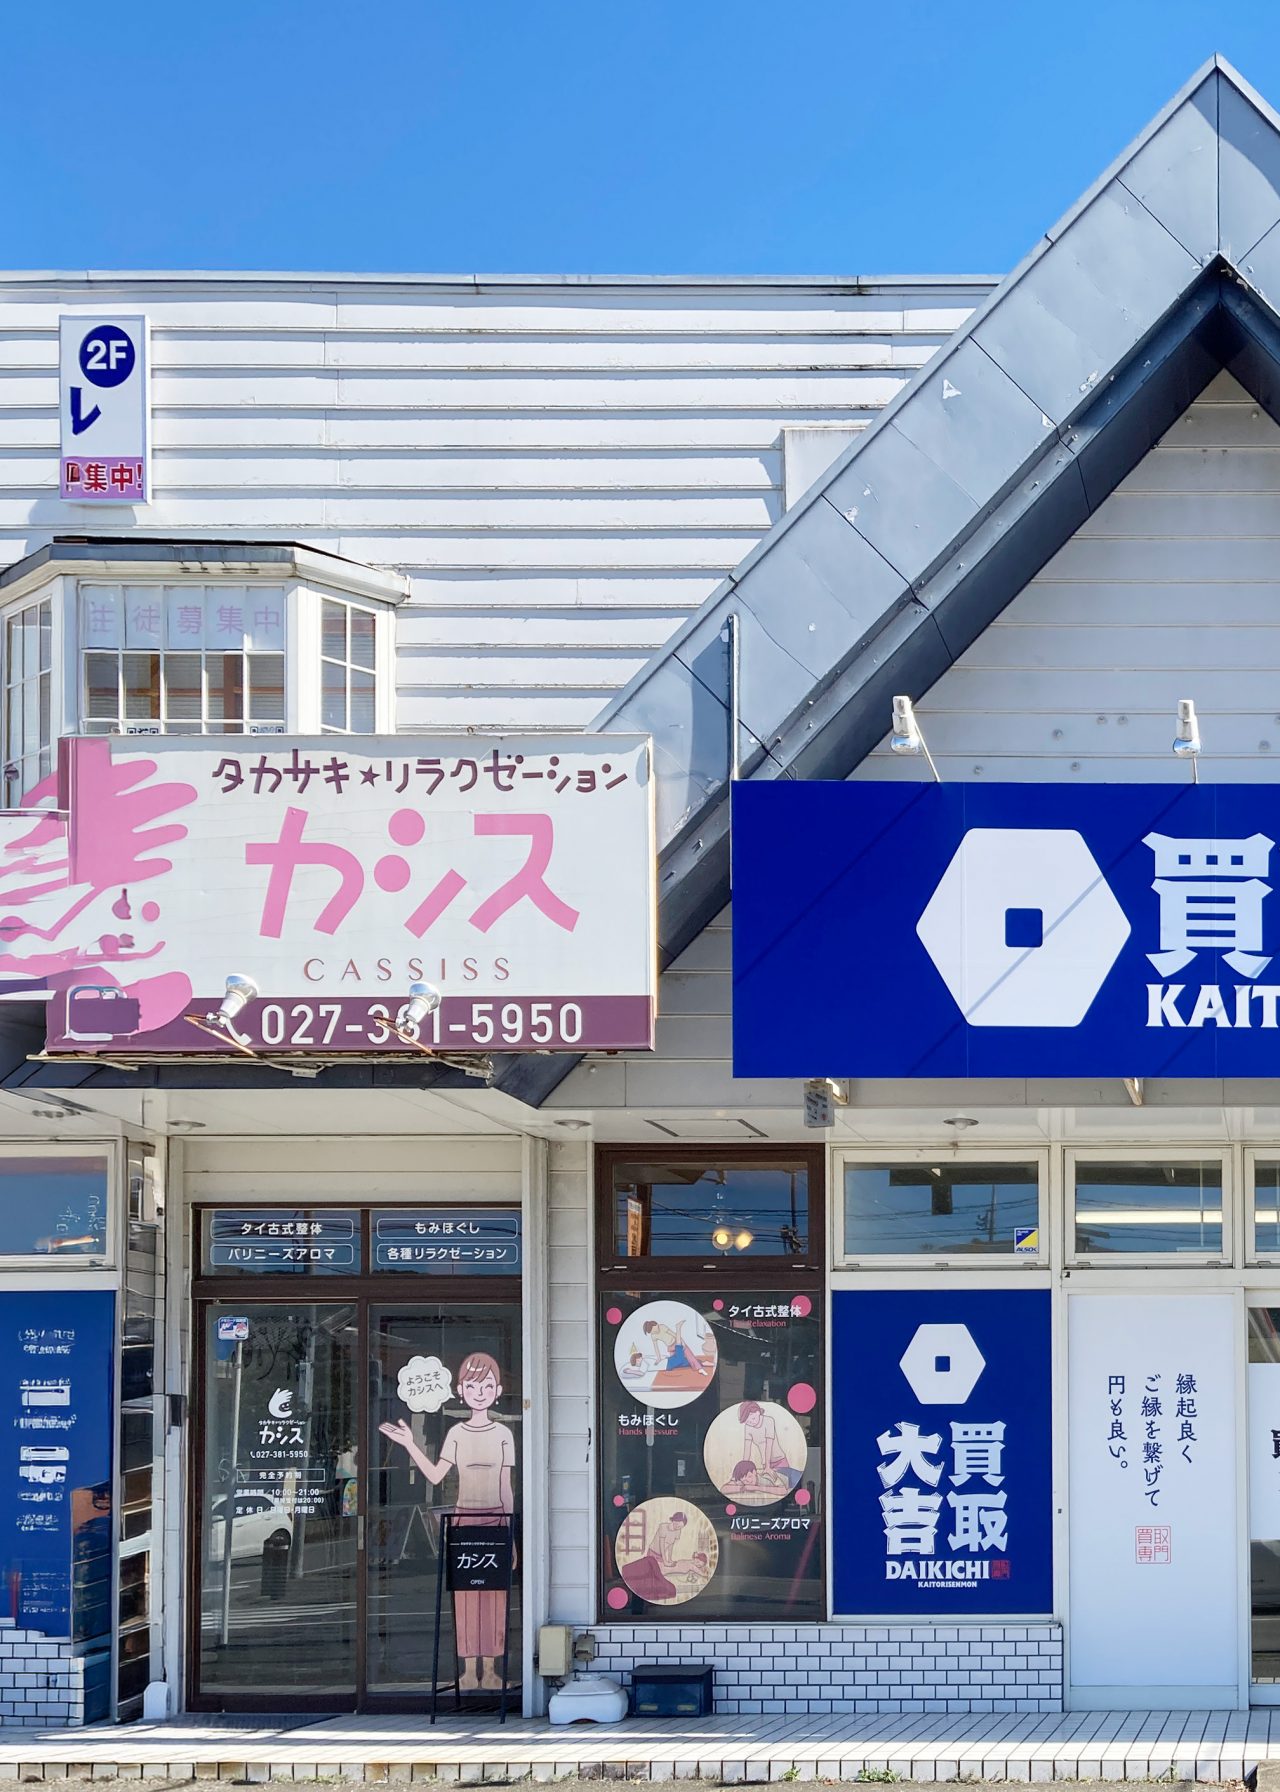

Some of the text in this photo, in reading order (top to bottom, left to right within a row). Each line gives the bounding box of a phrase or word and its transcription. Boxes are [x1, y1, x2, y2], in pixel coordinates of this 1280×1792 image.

[86, 339, 128, 370] 2F
[90, 602, 280, 635] 生徒募集中
[245, 806, 580, 939] カシス
[303, 957, 511, 982] CASSISS
[241, 1222, 322, 1236] タイ古式整体
[415, 1222, 480, 1235] もみほぐし
[228, 1248, 335, 1260] バリニーズアロマ
[387, 1247, 507, 1261] 各種リラクゼーション
[728, 1304, 802, 1318] タイ古式整体
[406, 1371, 441, 1386] ようこそ
[407, 1383, 444, 1397] カシスへ
[618, 1414, 679, 1427] もみほぐし
[1107, 1375, 1128, 1469] 円も良い。
[1175, 1373, 1198, 1464] 縁起良く
[259, 1425, 304, 1445] カシス
[618, 1427, 643, 1436] Hands
[1141, 1374, 1164, 1507] ご縁を繋げて
[255, 1450, 309, 1459] 027-381-5950
[730, 1517, 811, 1530] バリニーズアロマ
[765, 1532, 791, 1541] Aroma
[456, 1552, 498, 1569] カシス
[885, 1560, 990, 1580] DAIKICHI
